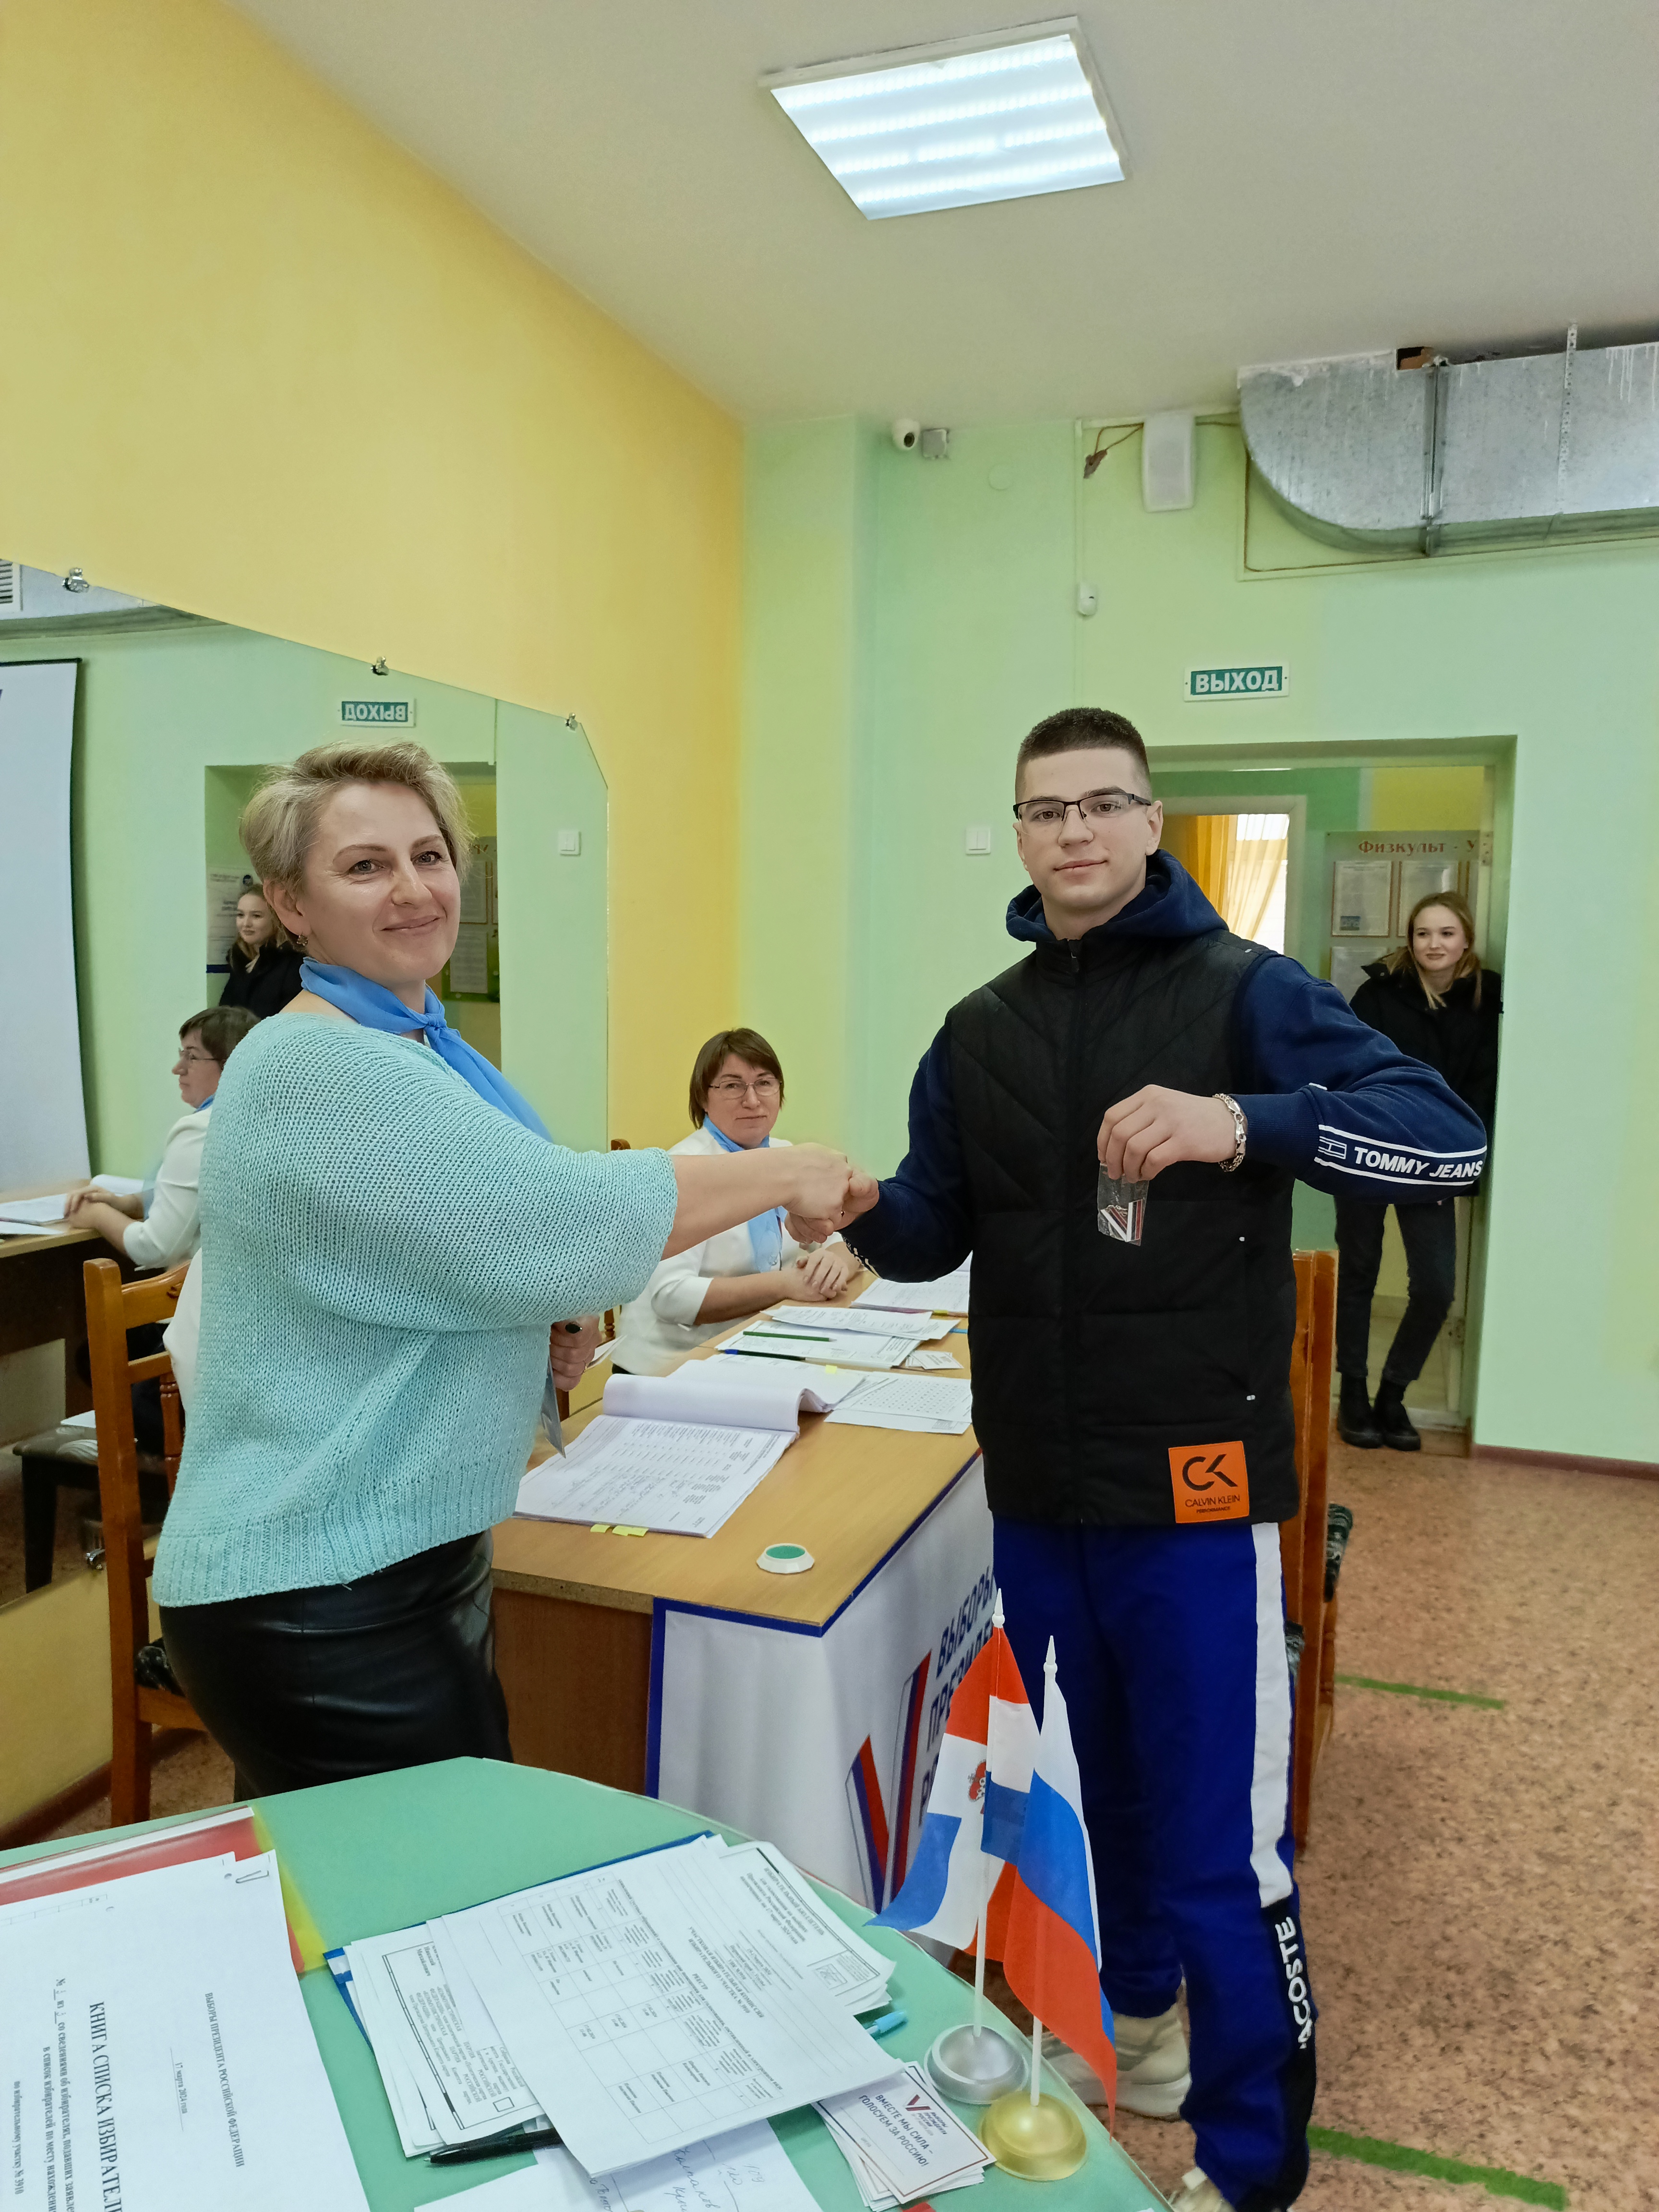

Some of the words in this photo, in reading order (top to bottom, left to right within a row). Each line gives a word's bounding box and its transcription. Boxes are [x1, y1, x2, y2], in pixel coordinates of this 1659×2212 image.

[1196, 670, 1278, 693] ВЫХОД
[1358, 840, 1446, 856] Физкульт
[1354, 1146, 1430, 1175] TOMMY
[1429, 1160, 1483, 1178] JEANS
[1182, 1454, 1238, 1491] CK
[1185, 1497, 1215, 1507] CALVIN
[1218, 1494, 1240, 1504] KLEIN
[936, 1565, 993, 1679] ВЫБОРЫ
[1275, 1917, 1313, 2049] ACOSTE
[57, 2000, 64, 2008] из
[204, 1993, 217, 2022] ВЫБОРЫ
[57, 2022, 65, 2031] со
[89, 2001, 108, 2053] КНИГА
[57, 2032, 67, 2077] сведениями
[210, 2023, 225, 2068] ПРЕЗИДЕНТА
[43, 2053, 51, 2079] список
[173, 2070, 184, 2088] марта
[60, 2078, 71, 2087] об
[92, 2055, 113, 2116] СПИСКА
[178, 2088, 188, 2102] 2024
[218, 2068, 237, 2117] РОССИЙСКОЙ
[12, 2090, 22, 2142] избирательному
[41, 2080, 56, 2128] избирателей
[58, 2087, 72, 2138] избирателях,
[45, 2130, 53, 2140] по
[857, 2094, 893, 2127] ГОЛОСУЕМ
[887, 2127, 902, 2136] ЗА
[895, 2135, 929, 2167] РОССИЮ!
[874, 2094, 903, 2119] ВМЕСТЕ
[897, 2118, 914, 2131] МЫ
[909, 2130, 929, 2150] СИЛА
[916, 2113, 933, 2127] РОССИИ
[923, 2112, 947, 2134] ПРЕЗИДЕНТА
[12, 2143, 22, 2168] участку
[43, 2141, 55, 2163] месту
[228, 2117, 245, 2167] ФЕДЕРАЦИИ
[62, 2140, 73, 2180] подавших
[14, 2178, 24, 2194] 3910
